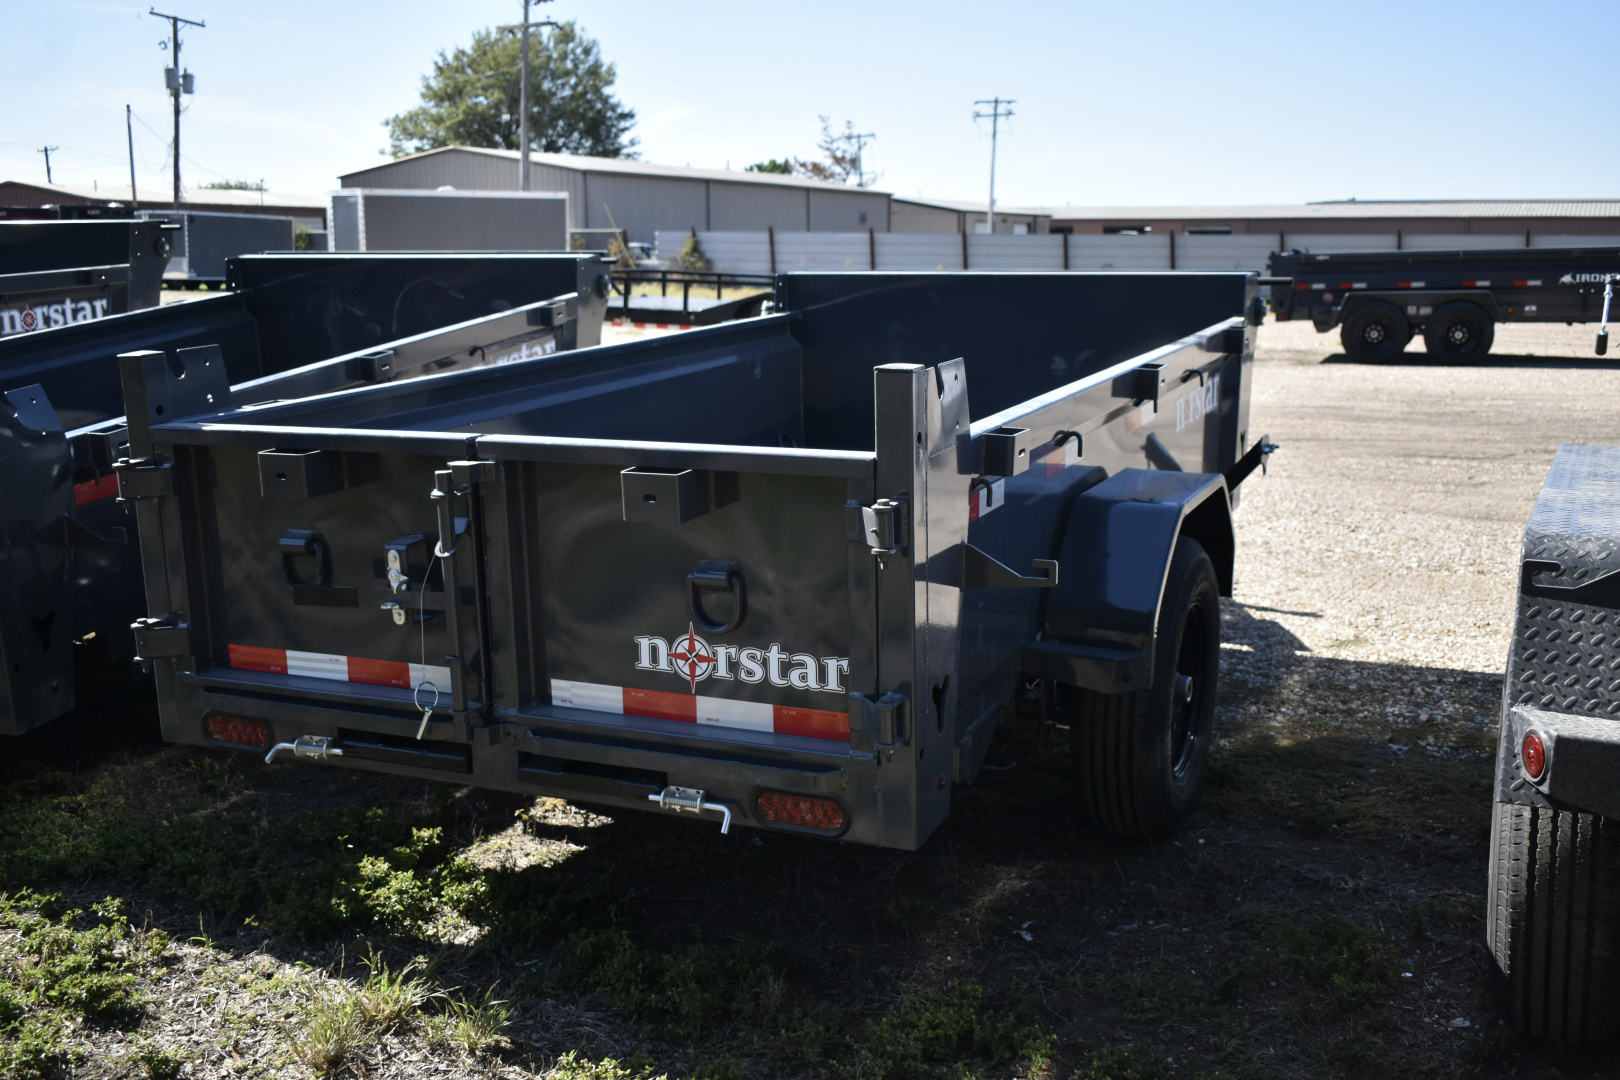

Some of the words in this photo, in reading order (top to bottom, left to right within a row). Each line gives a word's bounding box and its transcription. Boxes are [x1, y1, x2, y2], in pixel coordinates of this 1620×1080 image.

[0, 297, 107, 335] norstar
[1176, 372, 1220, 434] norstar
[634, 621, 849, 694] norstar
